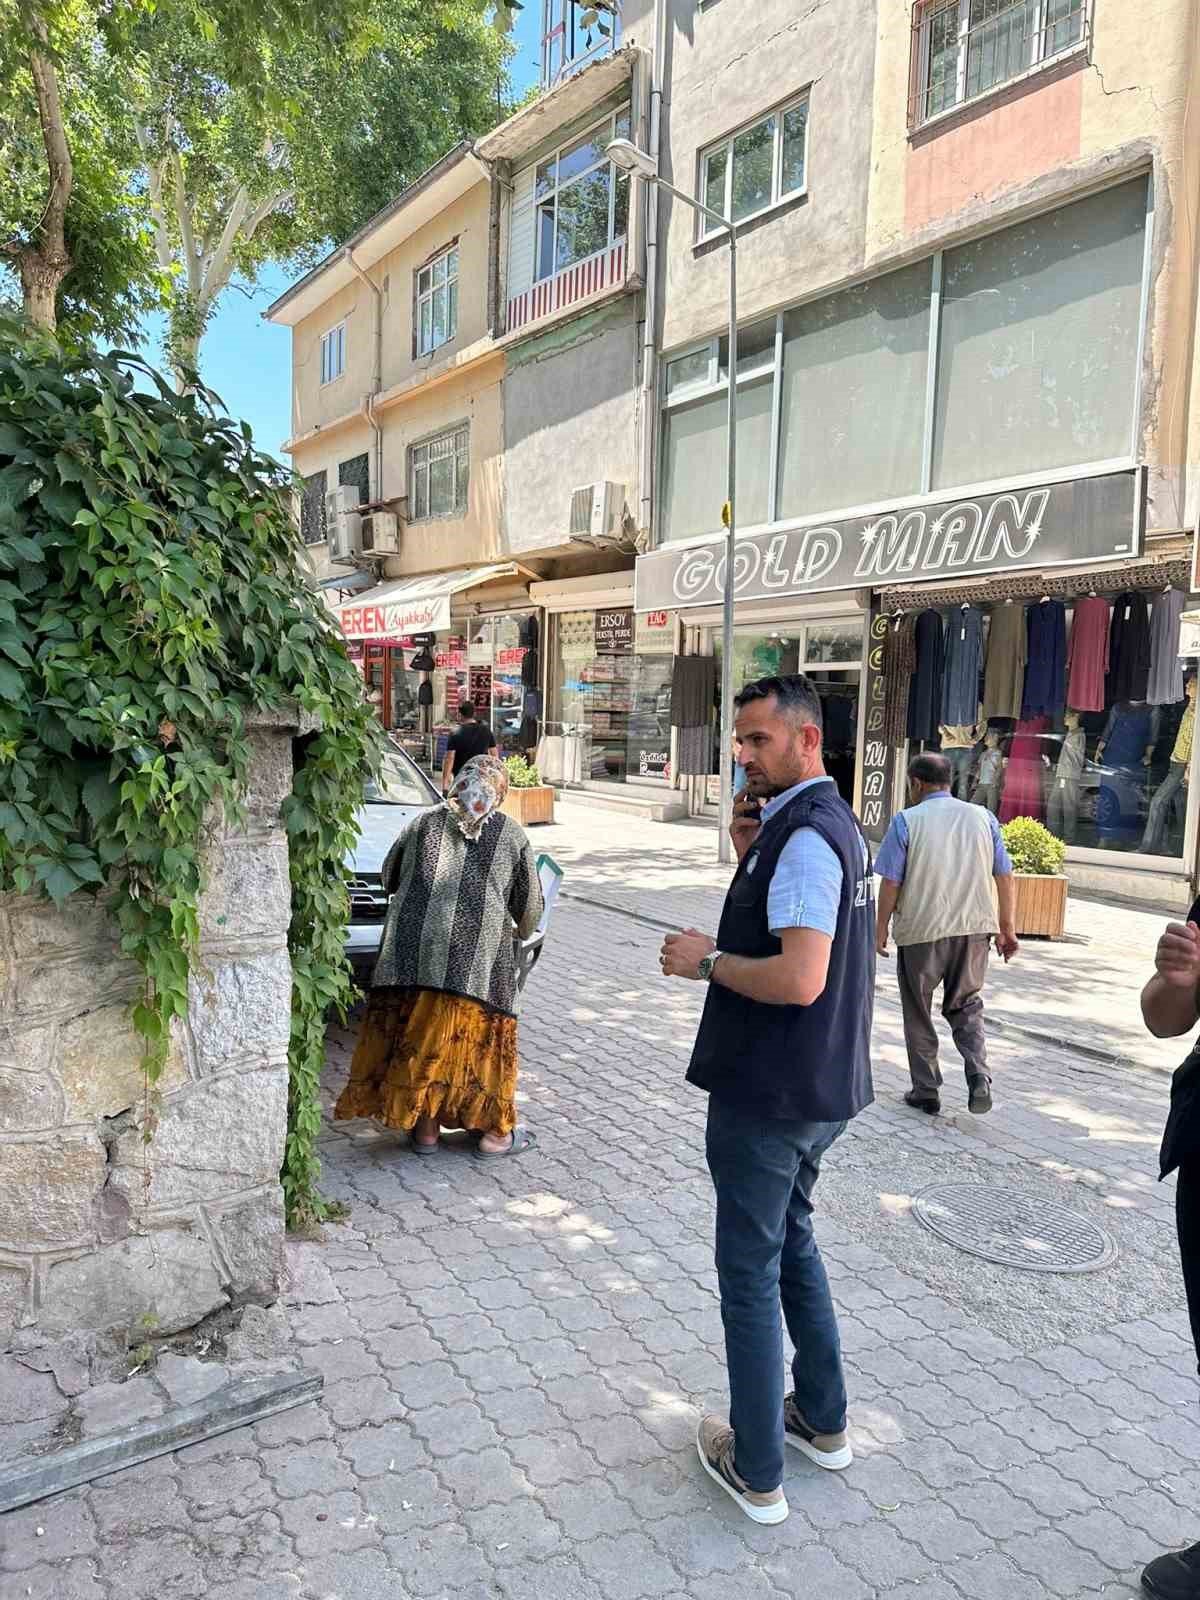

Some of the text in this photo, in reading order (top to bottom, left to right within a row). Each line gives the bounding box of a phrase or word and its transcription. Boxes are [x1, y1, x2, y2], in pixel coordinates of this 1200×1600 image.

[673, 488, 1051, 600] GOLD MAN
[340, 607, 386, 634] EREN
[600, 613, 626, 627] ERSOY
